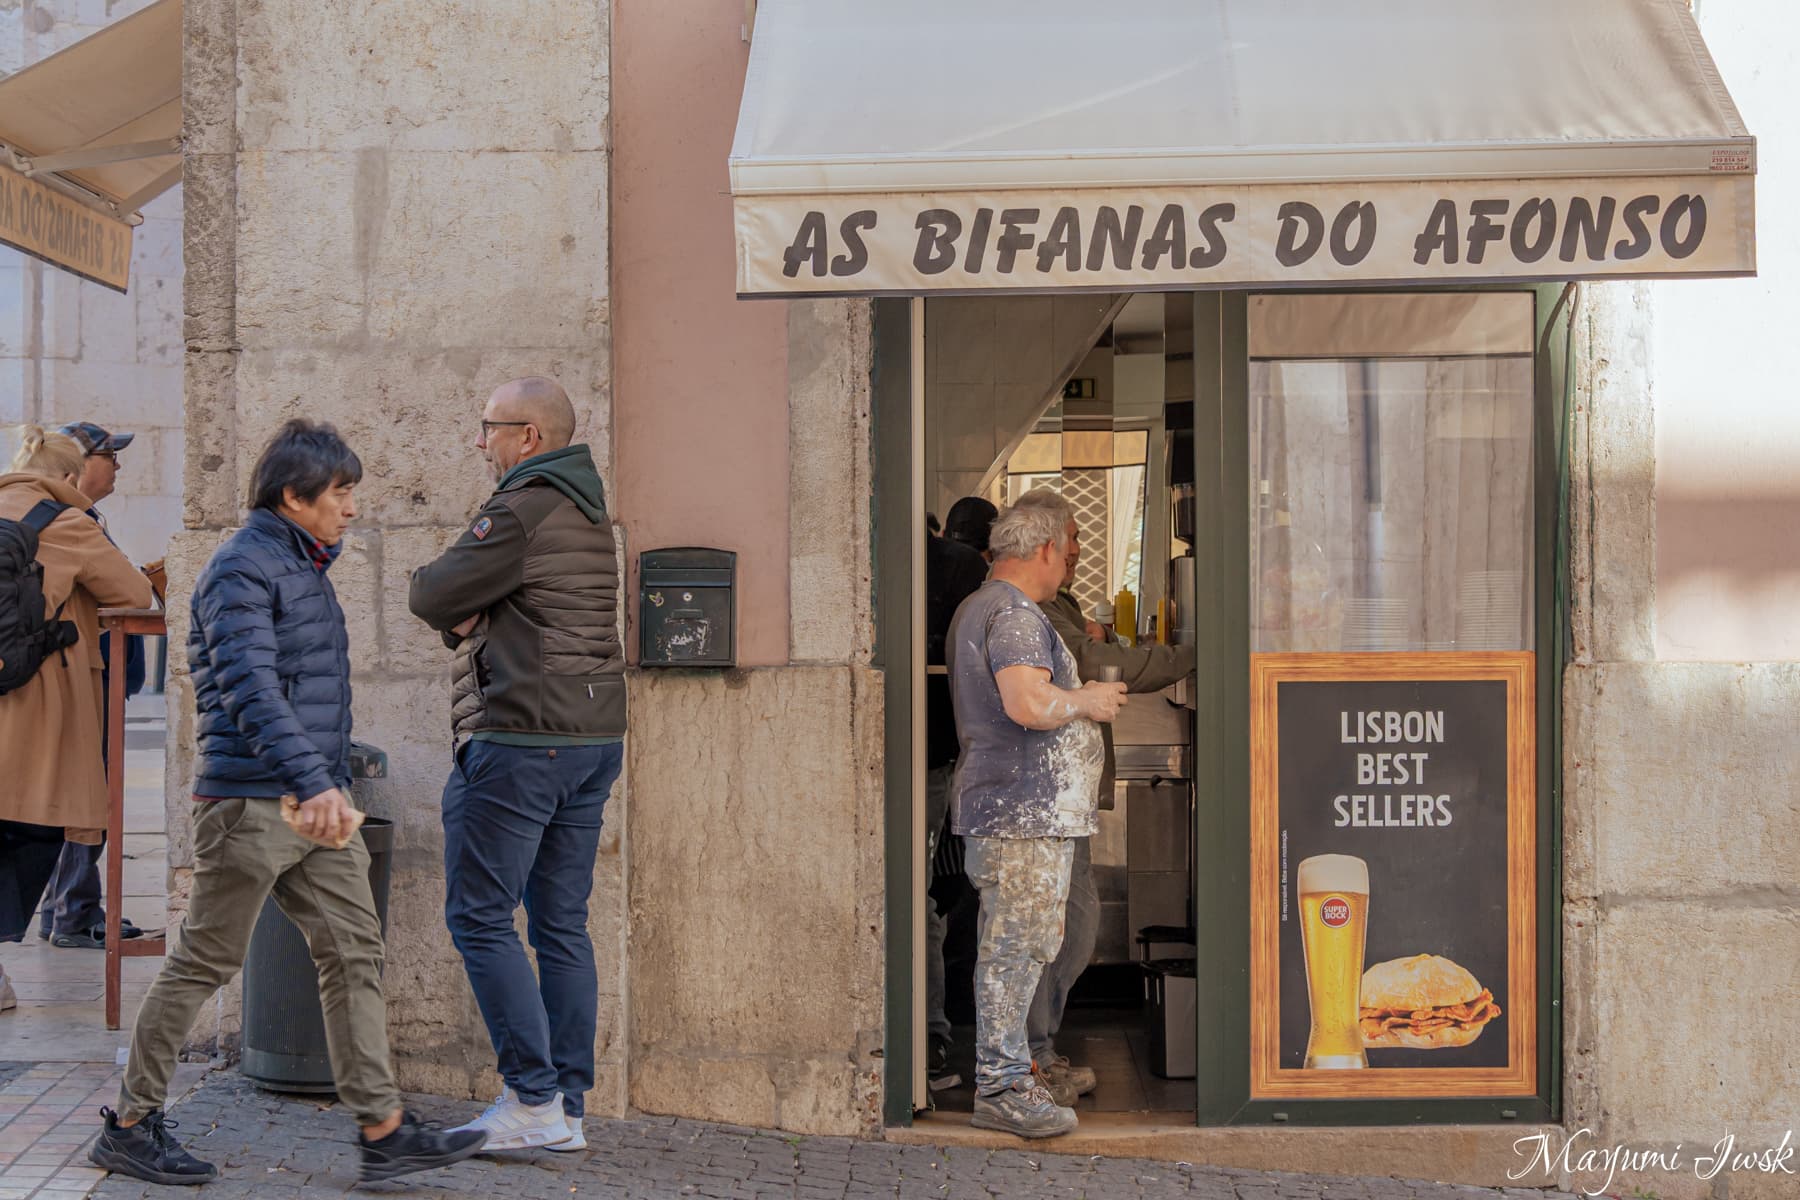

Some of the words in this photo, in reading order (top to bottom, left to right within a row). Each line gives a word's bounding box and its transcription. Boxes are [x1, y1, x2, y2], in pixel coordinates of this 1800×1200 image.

[783, 210, 877, 277] AS
[912, 203, 1236, 275] BIFANAS
[1275, 201, 1377, 267] DO
[1413, 194, 1707, 264] AFONSO
[1341, 711, 1444, 743] LISBON
[1357, 753, 1428, 784] BEST
[1333, 795, 1453, 827] SELLERS
